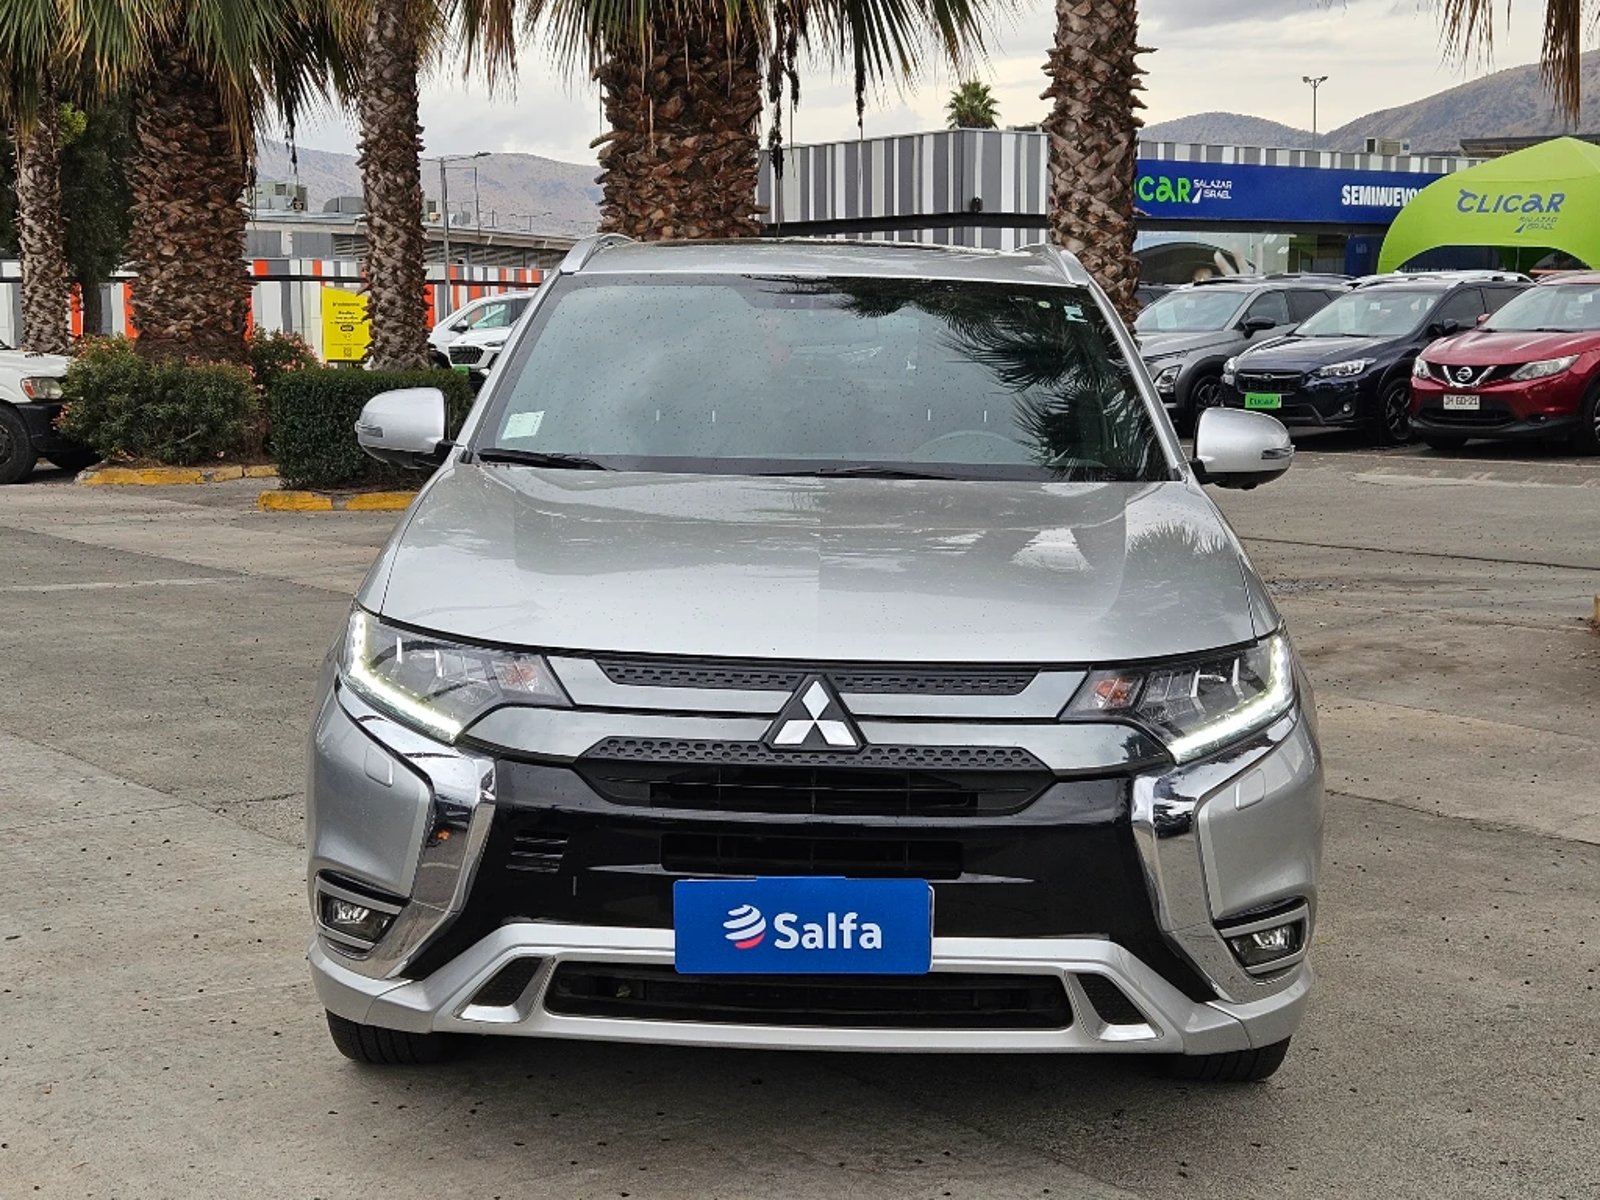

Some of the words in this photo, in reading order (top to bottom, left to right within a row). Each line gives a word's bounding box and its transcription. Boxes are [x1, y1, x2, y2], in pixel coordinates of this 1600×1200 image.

[1193, 179, 1232, 189] SALAZAR
[1203, 188, 1232, 199] ISRAEL
[1341, 184, 1423, 207] SEMINUEVO
[773, 912, 883, 950] Salfa
